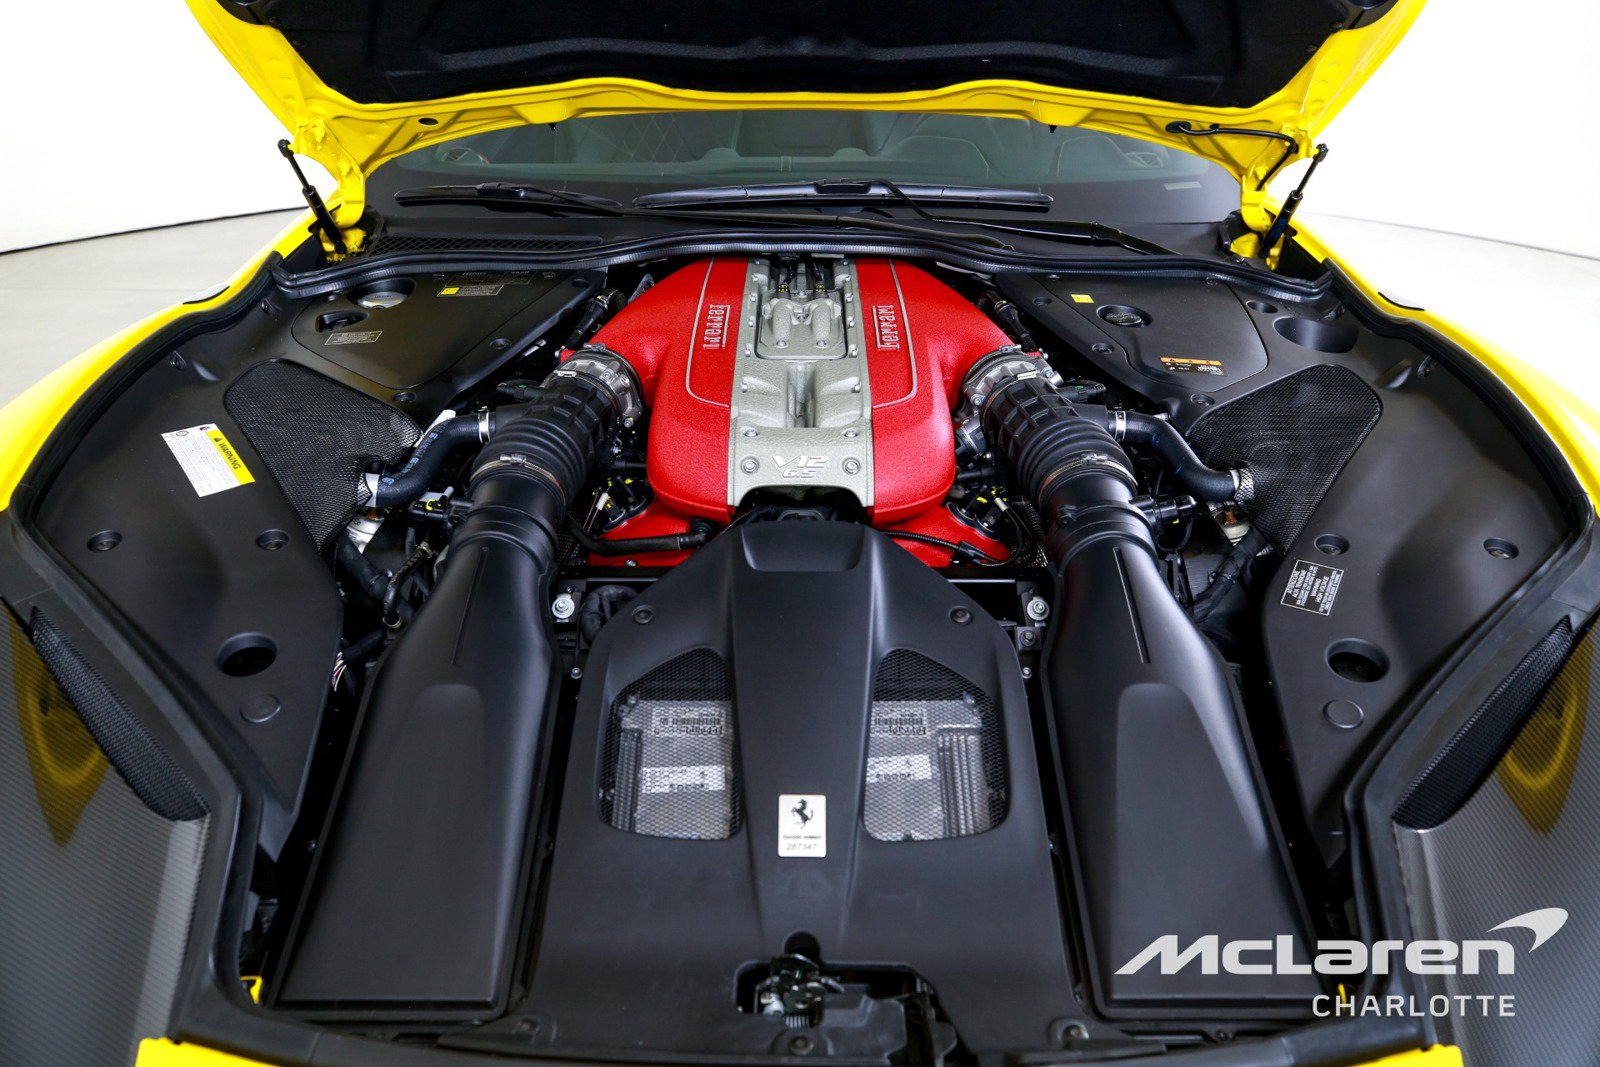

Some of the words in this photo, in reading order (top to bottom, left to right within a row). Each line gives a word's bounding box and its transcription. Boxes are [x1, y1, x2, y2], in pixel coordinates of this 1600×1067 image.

[702, 304, 731, 350] Ferrari
[872, 304, 900, 351] Ferrari
[218, 442, 242, 470] WARNING
[771, 455, 829, 469] V12
